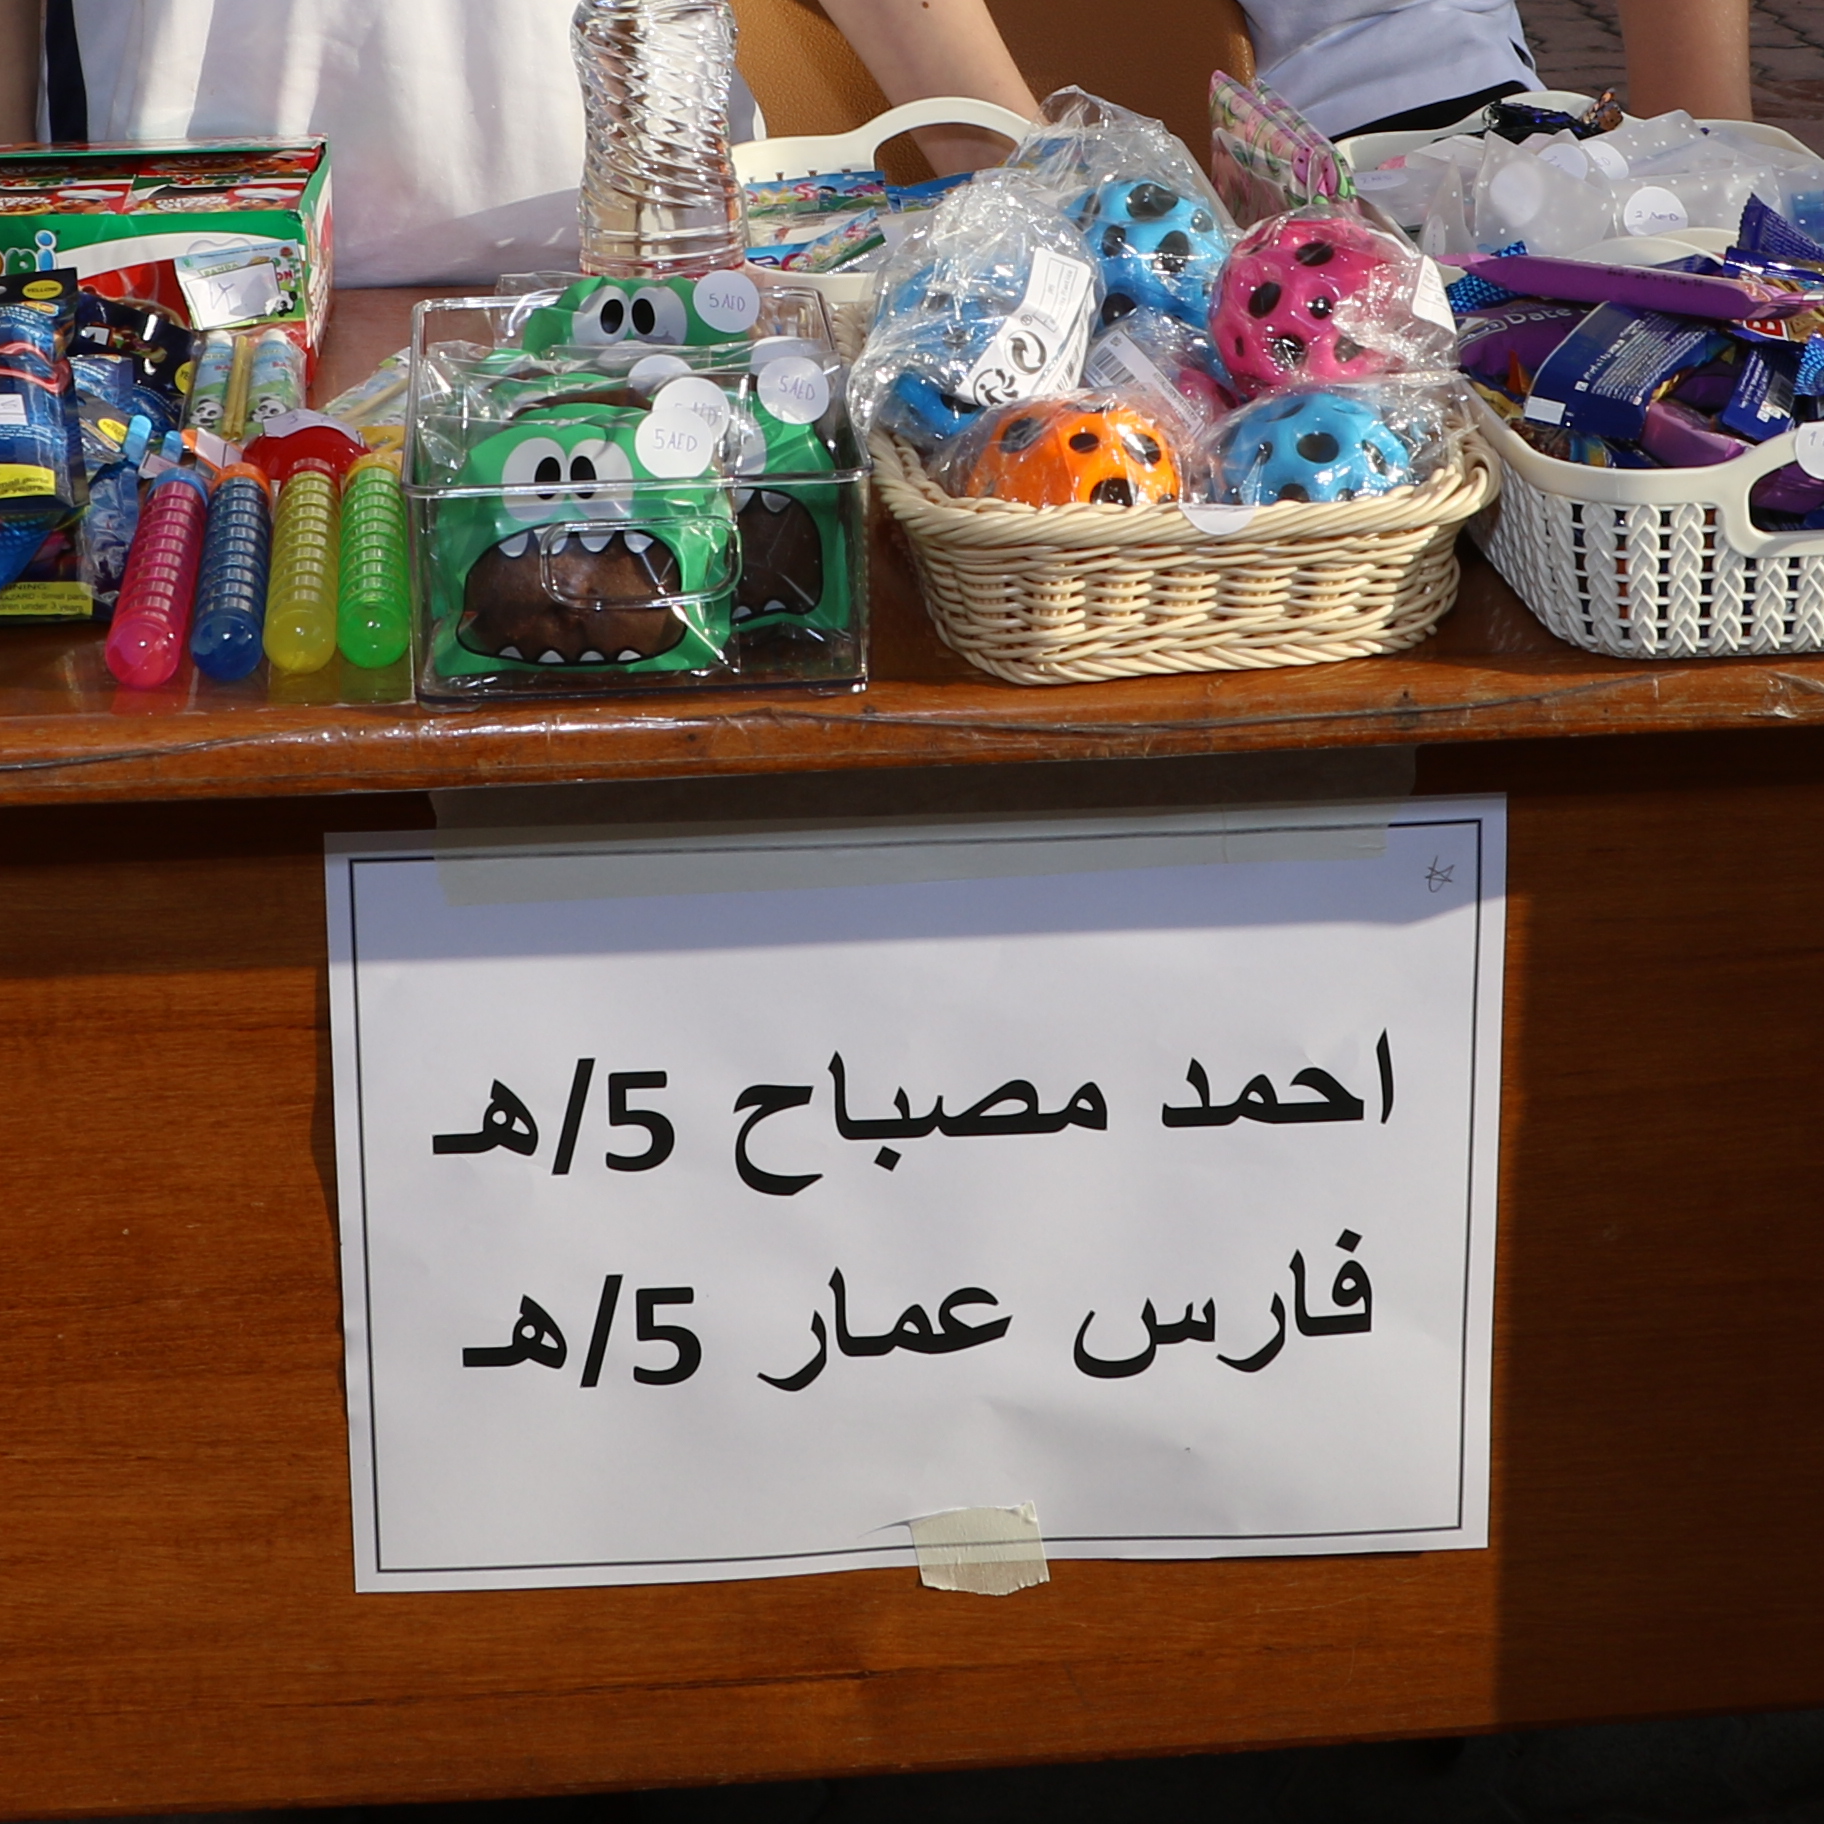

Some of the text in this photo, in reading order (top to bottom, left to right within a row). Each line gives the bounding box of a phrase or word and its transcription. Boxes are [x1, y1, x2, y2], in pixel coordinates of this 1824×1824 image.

[26, 286, 59, 294] YELLOW
[1504, 305, 1573, 325] Date
[732, 1049, 1110, 1197] مصباح
[1160, 1028, 1395, 1128] احمد
[756, 1266, 1014, 1393] عمار
[1072, 1229, 1375, 1380] فارس
